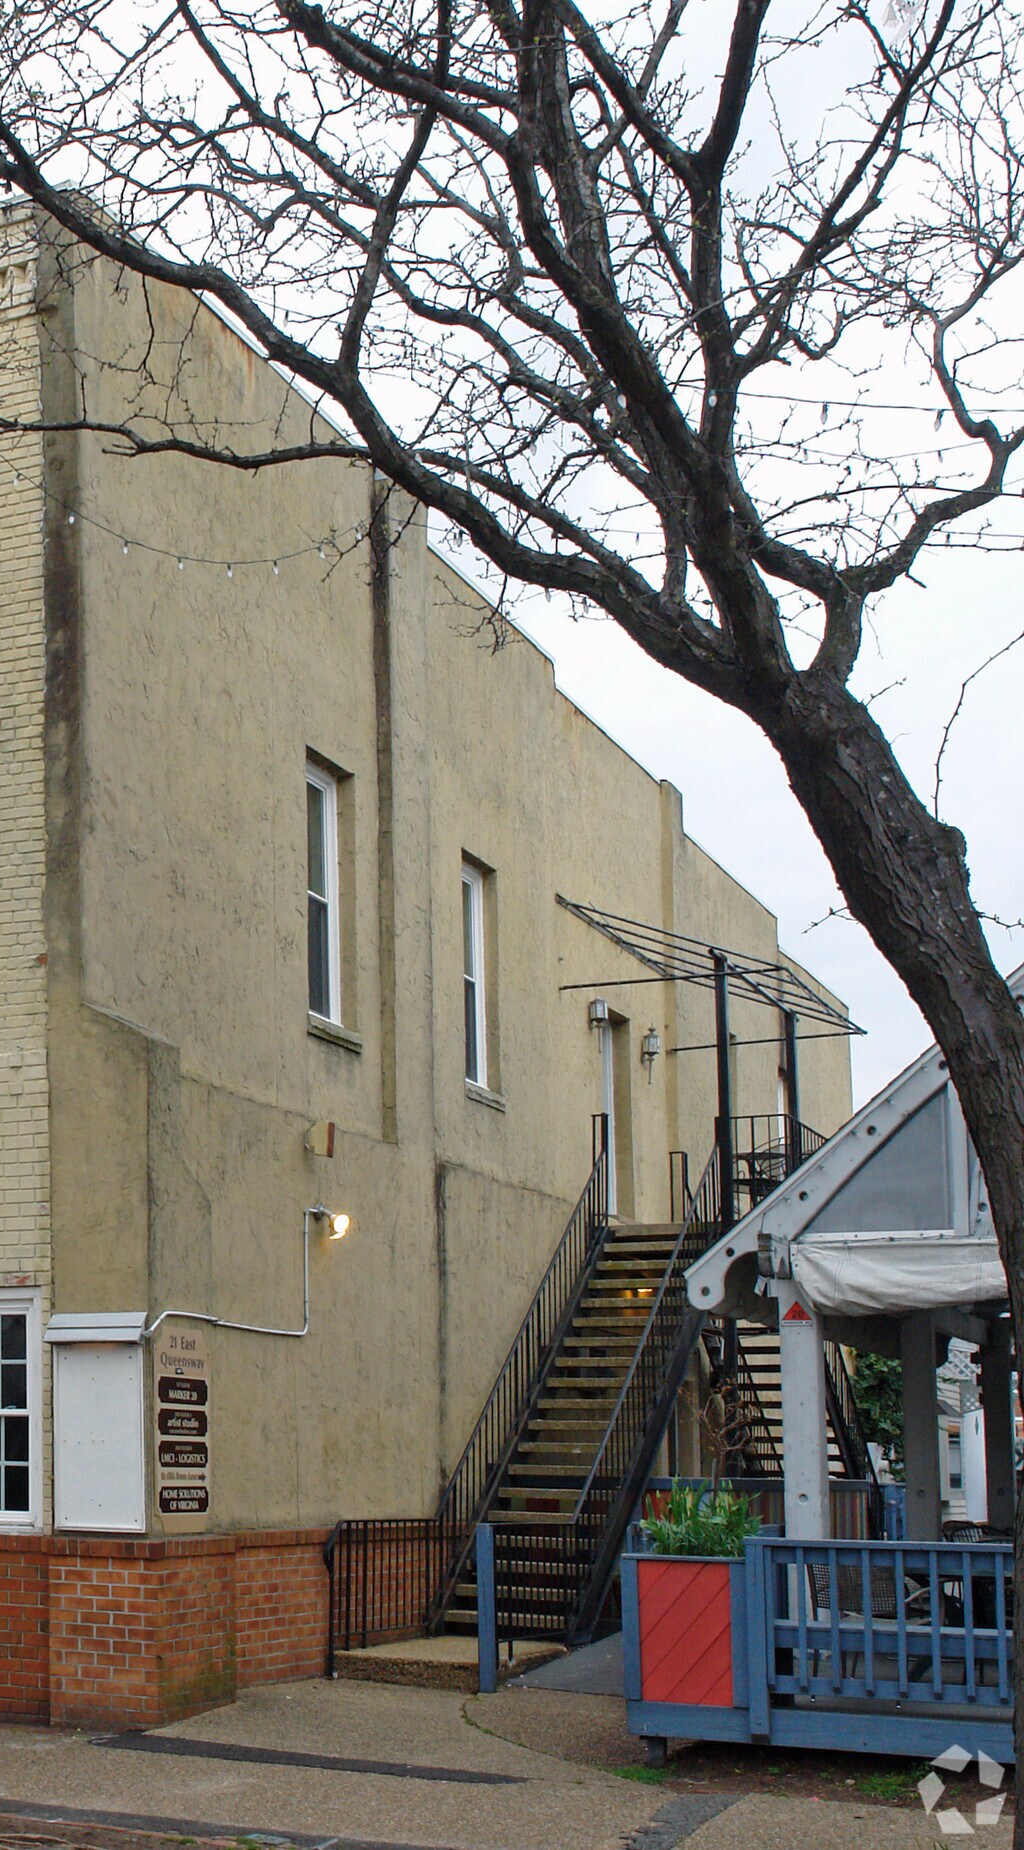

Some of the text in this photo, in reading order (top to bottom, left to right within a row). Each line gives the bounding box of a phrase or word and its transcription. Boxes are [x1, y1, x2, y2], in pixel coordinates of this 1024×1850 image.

[169, 1335, 196, 1351] 21 East
[160, 1352, 204, 1371] Queensway
[178, 1453, 206, 1463] LOGISTICS
[162, 1489, 206, 1499] HOME SOLUTIONS
